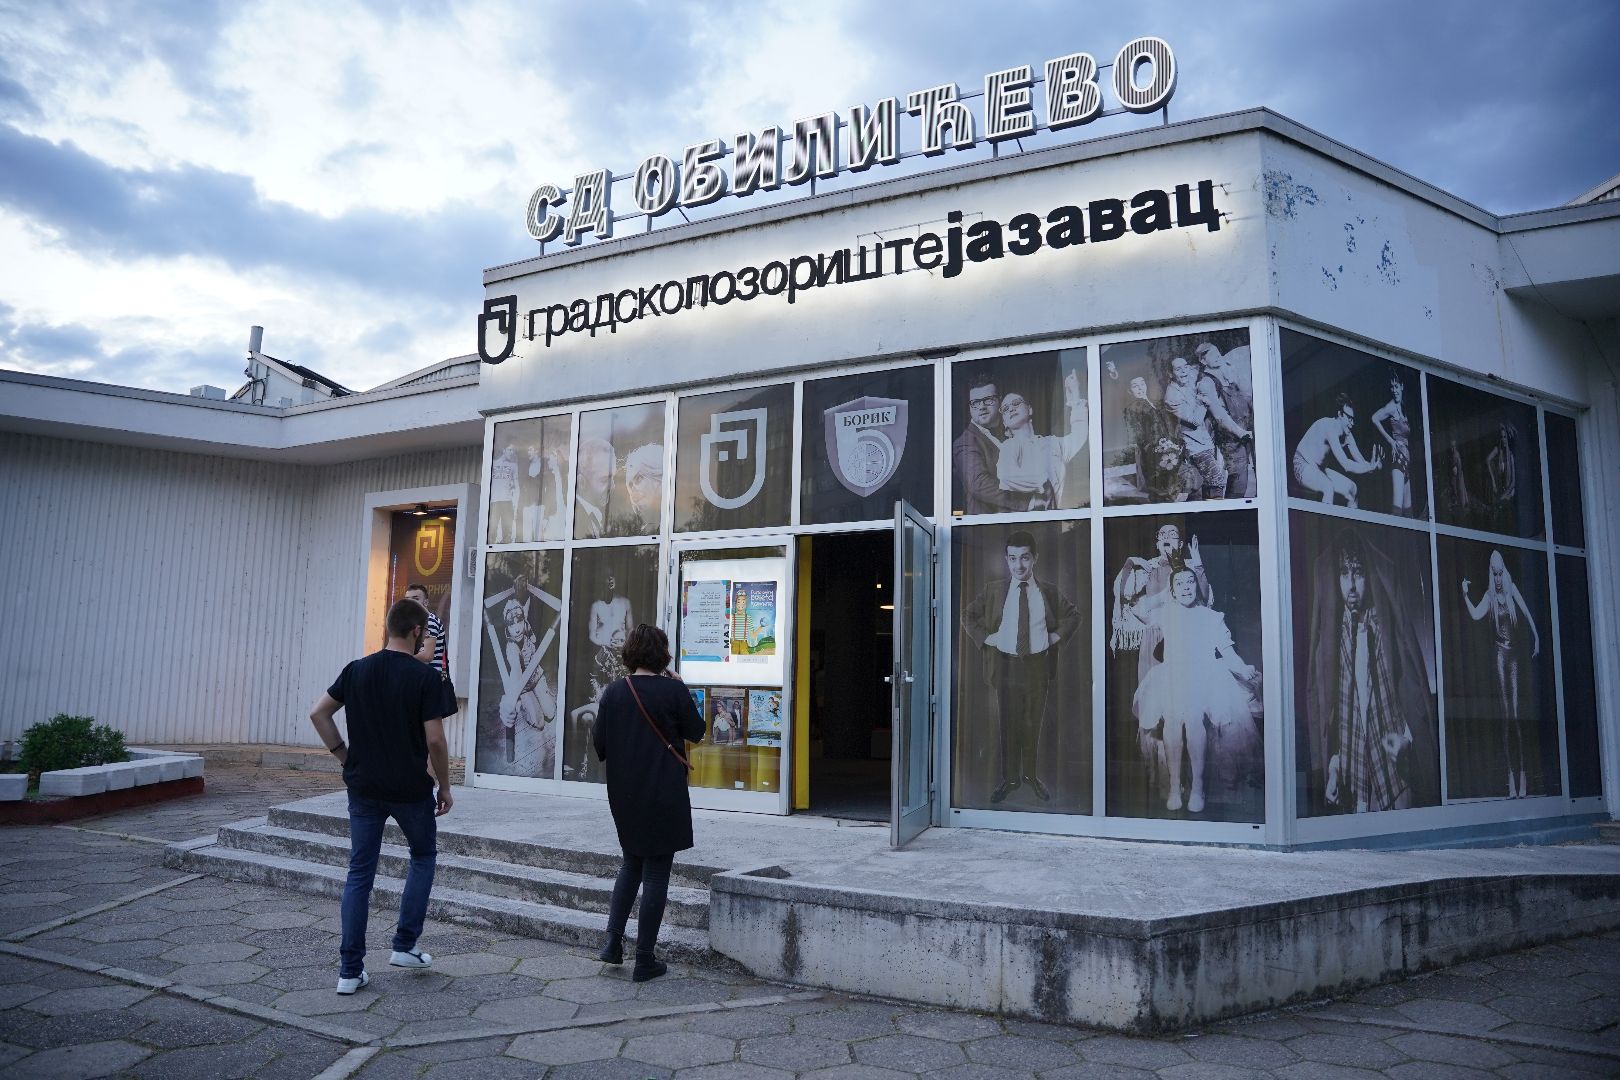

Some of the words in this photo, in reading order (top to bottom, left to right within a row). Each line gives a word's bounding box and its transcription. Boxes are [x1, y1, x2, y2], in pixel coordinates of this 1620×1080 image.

[525, 168, 613, 245] СД
[633, 36, 1177, 216] ОБИЛИЋЕВО
[843, 411, 891, 427] БОРИК
